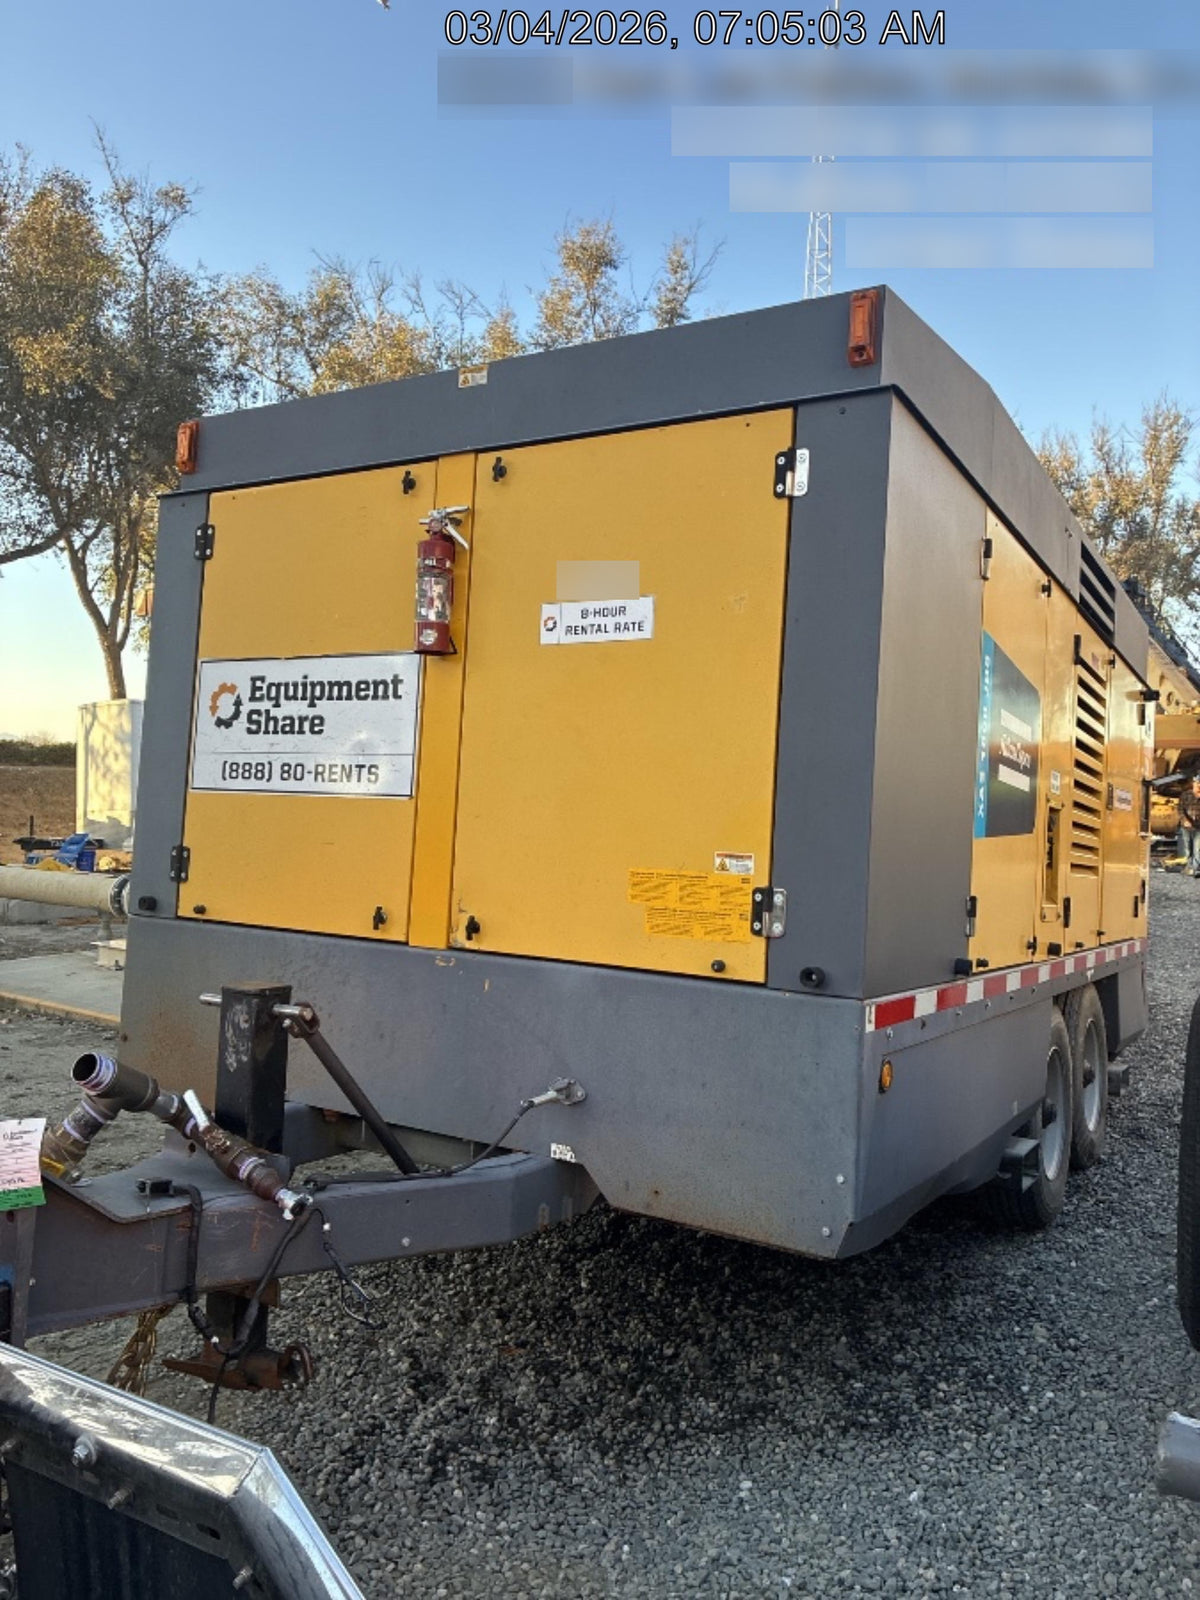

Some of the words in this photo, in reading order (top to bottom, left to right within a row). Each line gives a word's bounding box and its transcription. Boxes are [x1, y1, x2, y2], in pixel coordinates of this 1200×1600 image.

[581, 606, 626, 619] 8-HOUR
[565, 623, 610, 636] RENTAL
[614, 620, 645, 634] RATE
[248, 674, 403, 707] Equipment
[246, 709, 325, 735] Share
[221, 760, 273, 782] (888)
[280, 763, 379, 783] 80-RENTS
